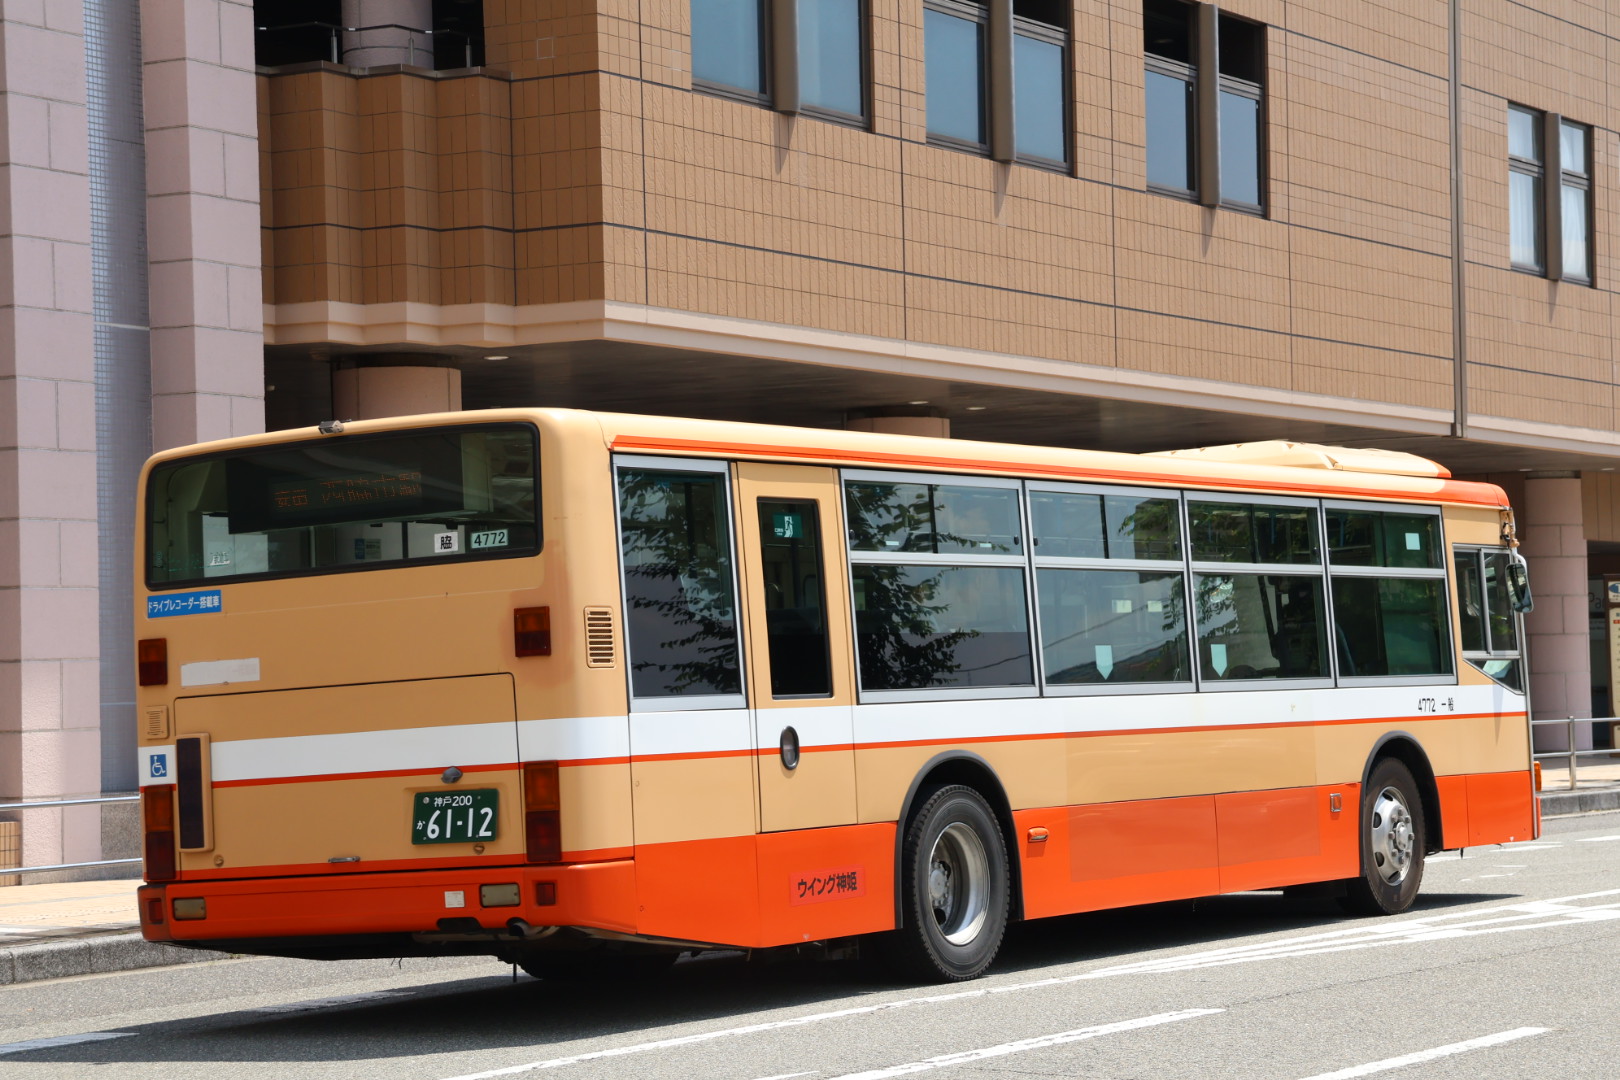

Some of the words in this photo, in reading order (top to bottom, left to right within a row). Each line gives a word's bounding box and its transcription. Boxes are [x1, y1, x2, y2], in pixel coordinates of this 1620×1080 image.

[473, 531, 506, 547] 4772
[148, 595, 220, 613] ドライブレコーダー搭載車
[1418, 698, 1436, 712] 4772
[433, 795, 473, 808] 神戸200
[416, 820, 426, 830] か
[426, 807, 493, 839] 61-12
[798, 872, 857, 898] ウイング神姫
